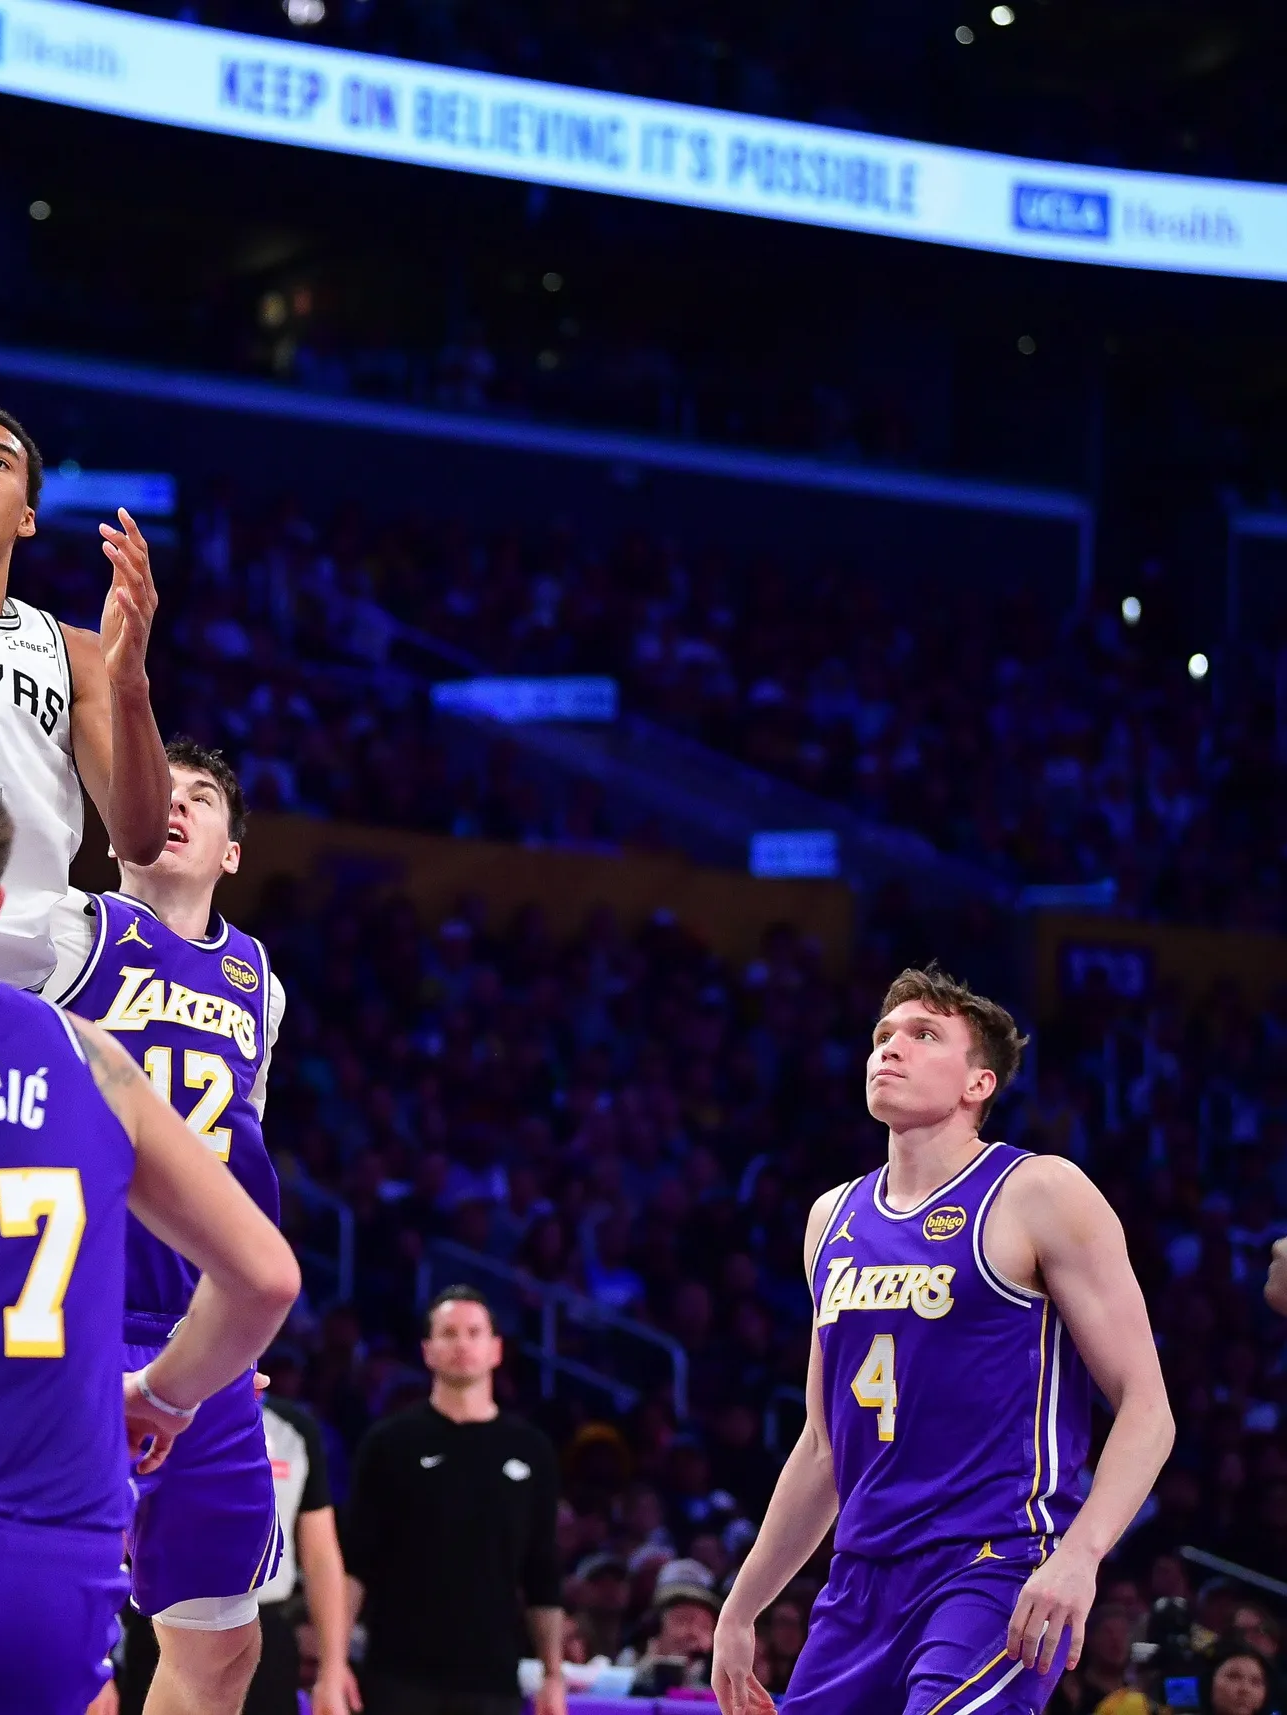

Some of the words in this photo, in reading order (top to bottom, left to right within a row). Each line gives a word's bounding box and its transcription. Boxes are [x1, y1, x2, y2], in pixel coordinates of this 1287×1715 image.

[220, 53, 328, 122] KEEP
[342, 73, 398, 131] ON
[414, 84, 626, 171] BELIEVING
[640, 117, 713, 184] IT'S
[727, 132, 916, 216] POSSIBLE
[1018, 188, 1107, 234] UCLA
[1121, 196, 1245, 248] Health
[13, 640, 49, 654] LEDGER
[224, 960, 256, 985] bibigo
[94, 965, 257, 1060] LAKERS
[143, 1045, 234, 1163] 12
[927, 1214, 964, 1231] bibigo
[817, 1256, 957, 1329] LAKERS
[850, 1333, 898, 1442] 4
